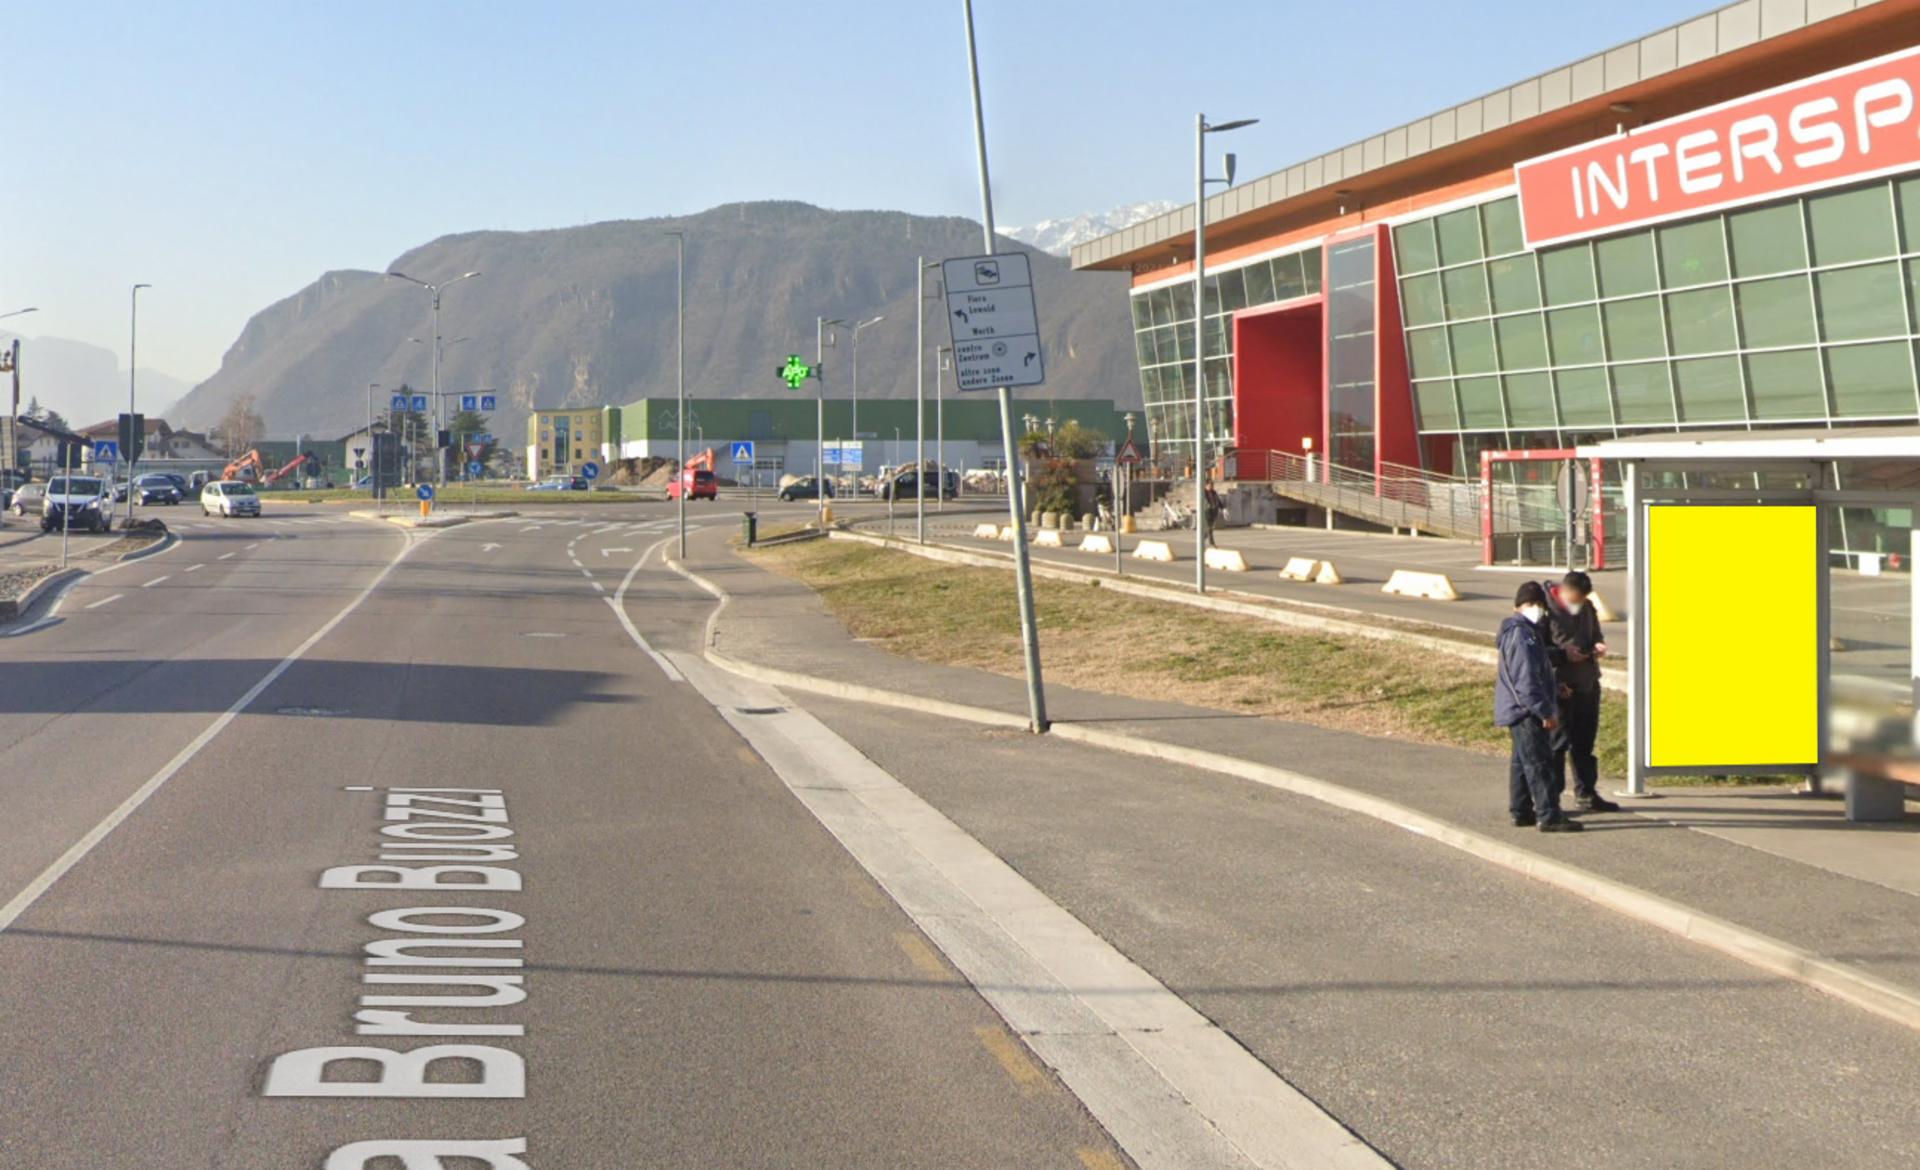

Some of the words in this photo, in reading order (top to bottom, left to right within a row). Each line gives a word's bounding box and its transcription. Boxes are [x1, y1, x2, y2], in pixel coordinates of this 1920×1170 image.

[1570, 77, 1920, 221] INTERSP
[959, 353, 990, 363] Zentrum
[961, 367, 980, 377] altre
[962, 377, 988, 386] andere
[318, 786, 523, 891] Buozzi
[262, 906, 528, 1098] Bruno
